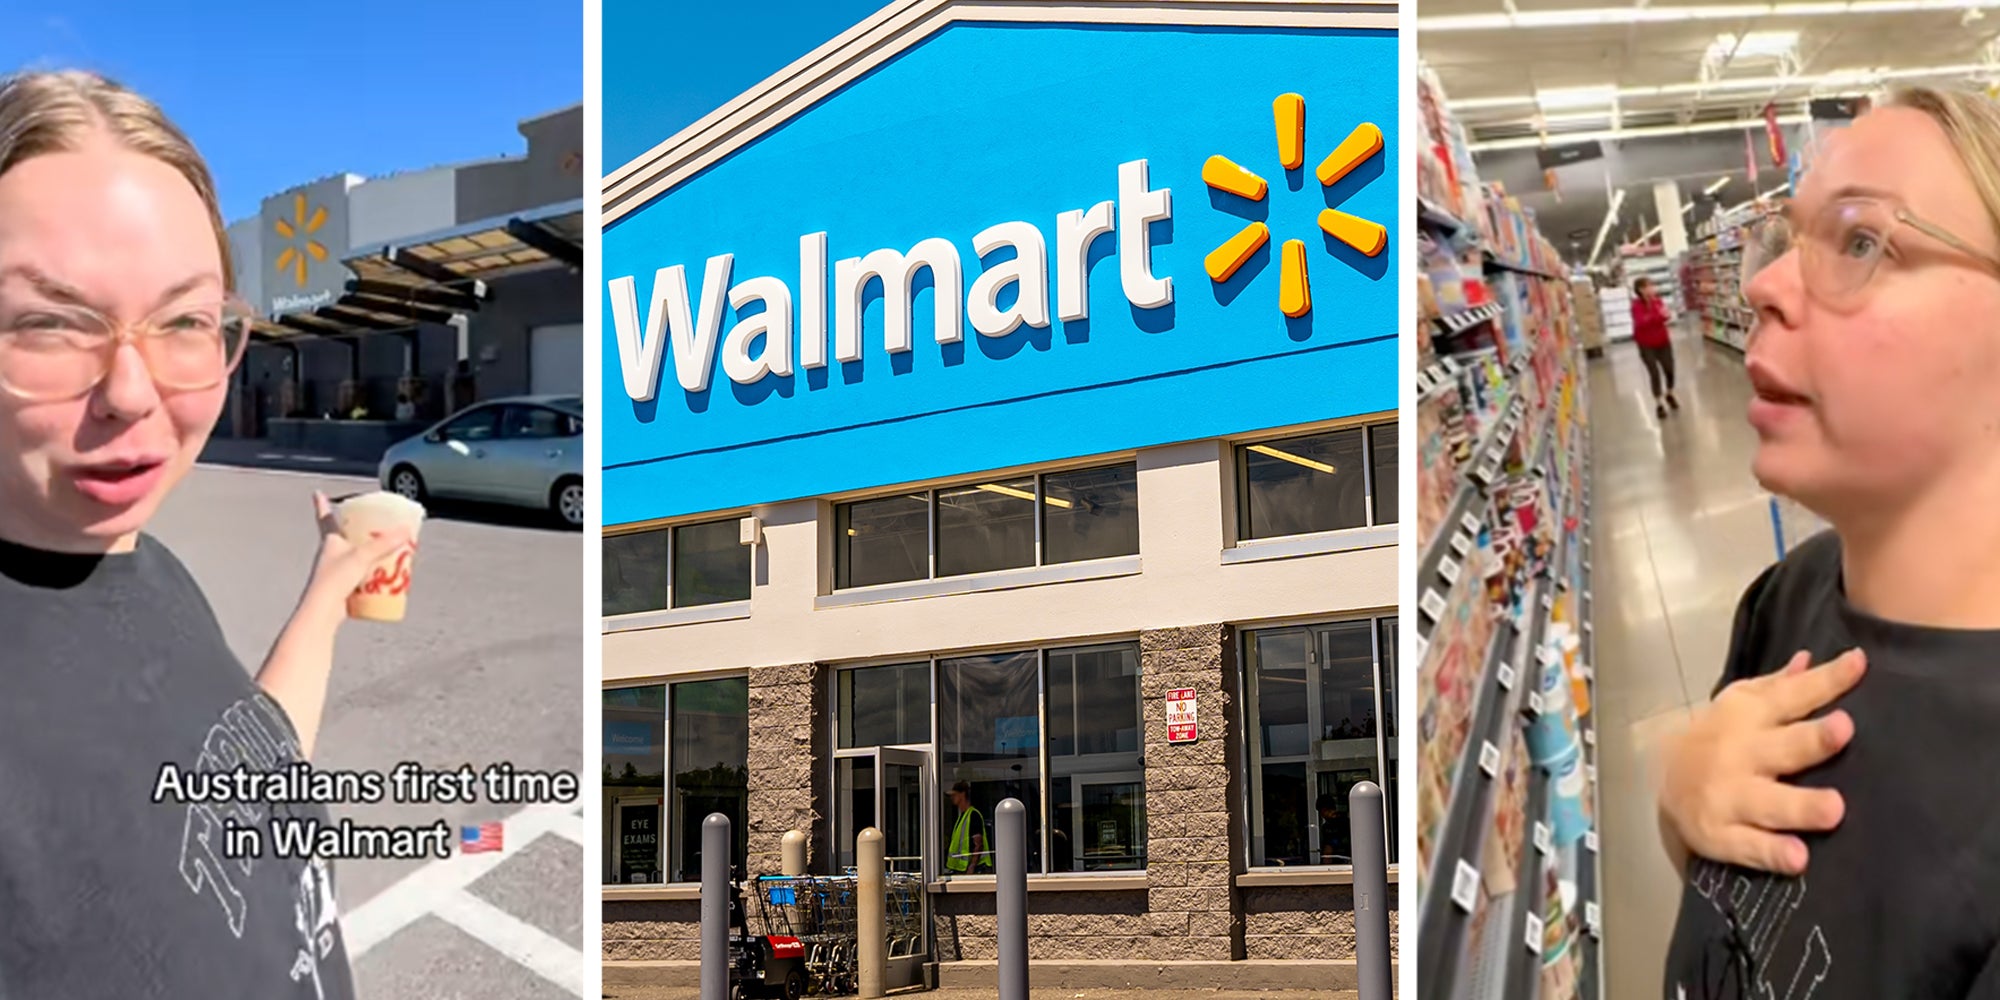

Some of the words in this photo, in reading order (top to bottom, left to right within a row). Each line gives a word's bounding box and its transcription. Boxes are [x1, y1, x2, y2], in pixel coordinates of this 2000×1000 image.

[608, 158, 1173, 402] Walmart
[1168, 691, 1179, 700] FIRE
[1180, 690, 1194, 699] LANE
[1176, 702, 1187, 712] NO
[1168, 712, 1194, 723] PARKING
[631, 819, 649, 829] EYE
[624, 833, 657, 845] EXAMS
